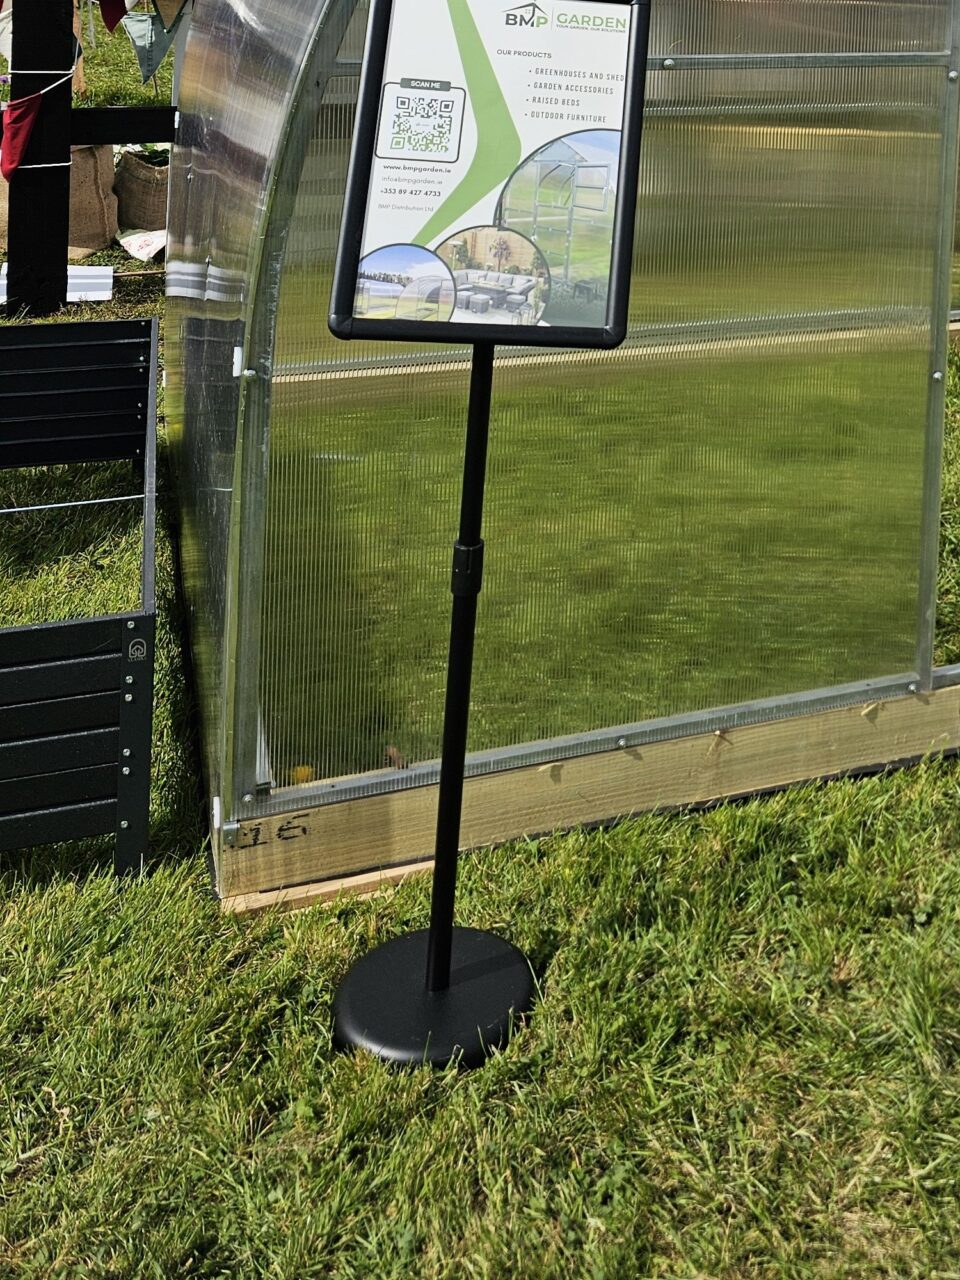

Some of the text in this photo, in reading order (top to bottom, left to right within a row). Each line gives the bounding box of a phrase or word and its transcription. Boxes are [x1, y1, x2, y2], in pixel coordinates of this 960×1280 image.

[505, 12, 627, 29] BMP GARDEN
[513, 50, 552, 59] PRODUCTS
[535, 67, 587, 78] GREENHOUSES
[589, 72, 604, 80] AND
[410, 80, 430, 88] SCAN
[533, 81, 614, 95] GARDEN ACCESSORIES
[532, 96, 580, 107] RAISED BEDS
[530, 111, 607, 123] OUTDOOR FURNITURE
[383, 164, 452, 174] www.bmpgarden.ie
[408, 189, 422, 197] 427
